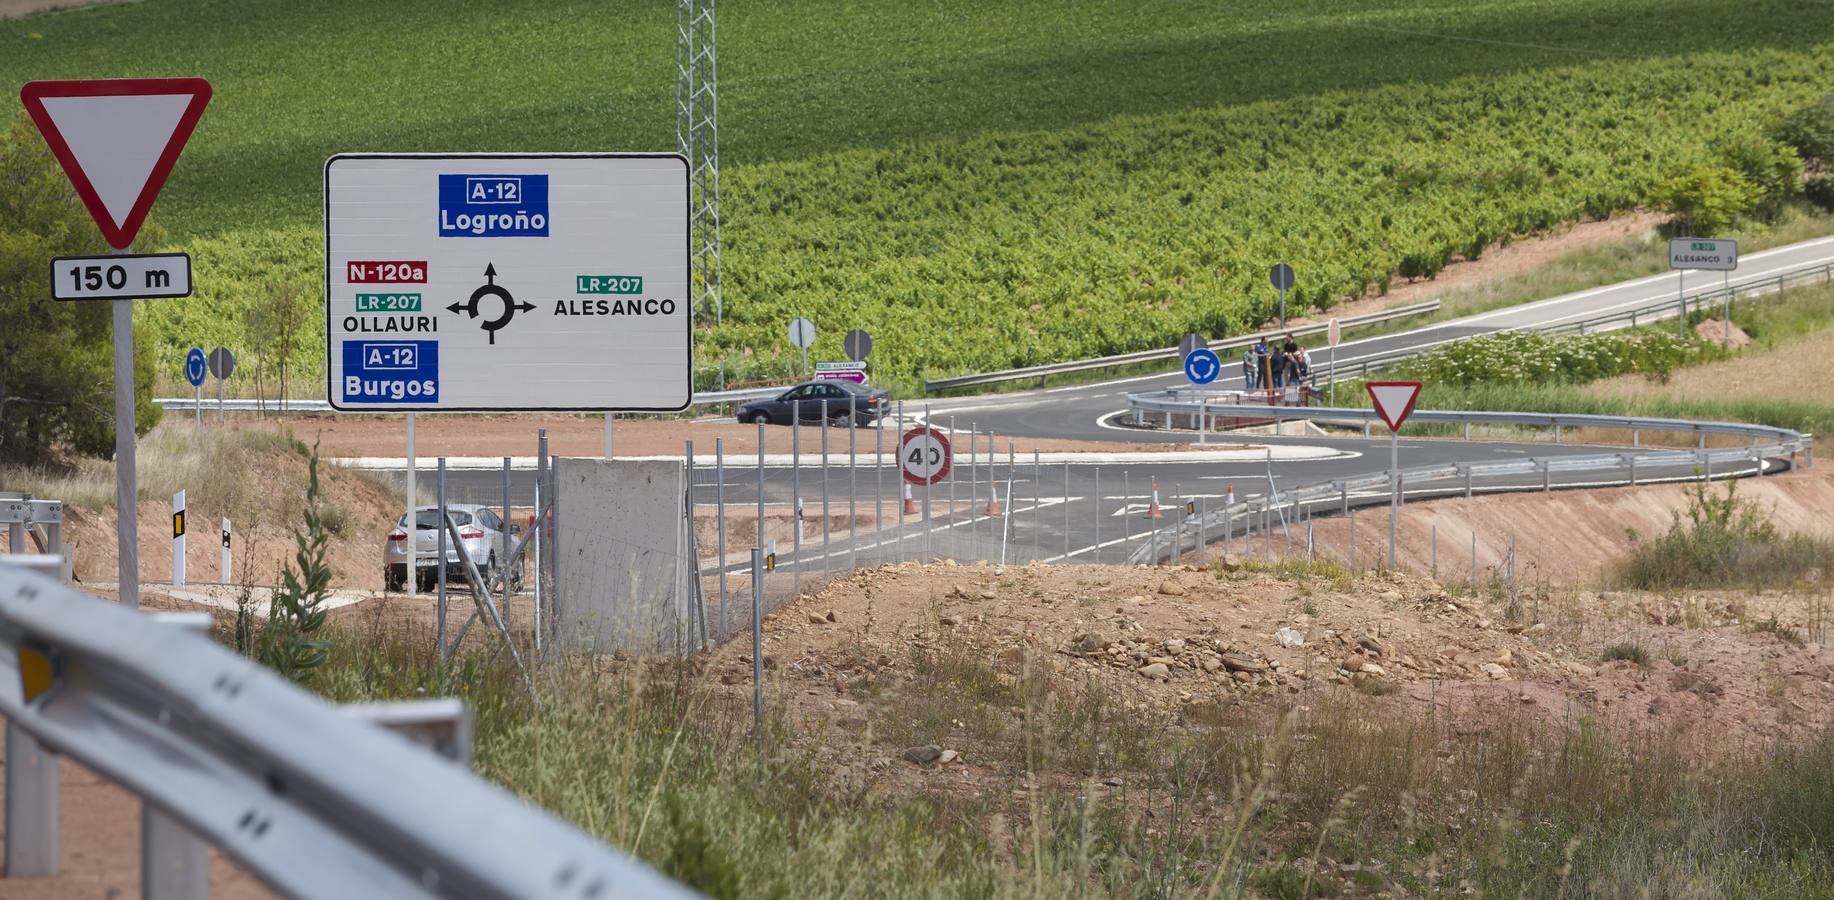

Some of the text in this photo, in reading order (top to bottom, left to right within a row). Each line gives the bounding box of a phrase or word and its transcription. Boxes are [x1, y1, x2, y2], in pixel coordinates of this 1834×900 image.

[472, 182, 517, 200] A-12
[441, 209, 546, 235] Logroño
[1673, 254, 1720, 263] ALESANCO
[69, 264, 170, 292] 150 m
[350, 263, 424, 281] N-120a
[578, 277, 641, 293] LR-207
[357, 296, 420, 311] LR-207
[553, 298, 676, 317] ALESANCO
[342, 315, 438, 333] OLLAURI
[368, 348, 414, 366] A-12
[345, 376, 437, 400] Burgos
[907, 447, 941, 465] 40
